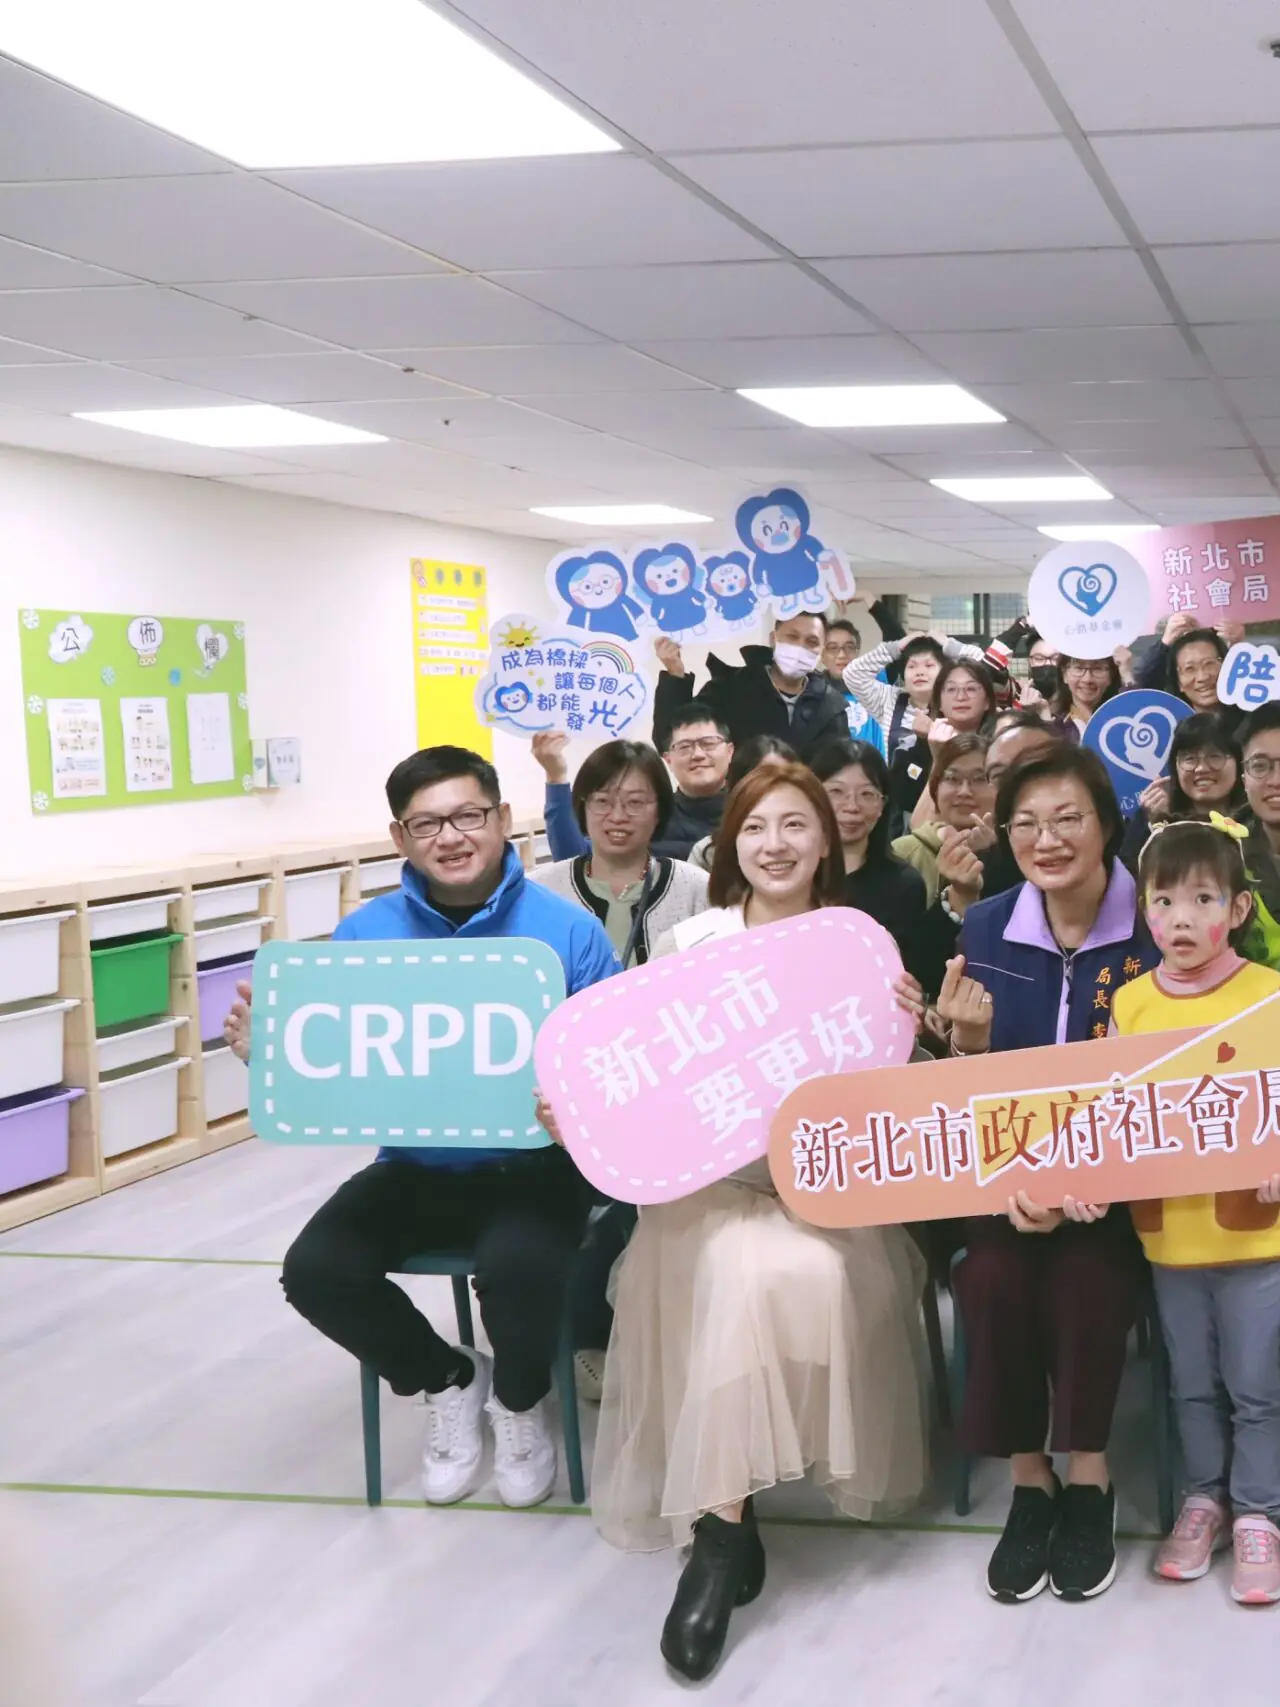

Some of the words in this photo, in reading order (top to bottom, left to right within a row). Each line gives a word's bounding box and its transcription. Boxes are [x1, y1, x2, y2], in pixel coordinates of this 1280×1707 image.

[1163, 539, 1265, 576] 新北市
[1167, 575, 1269, 611] 社會局
[501, 648, 590, 671] 成為橋樑
[537, 693, 581, 711] 都能
[554, 672, 635, 699] 讓每個人
[1093, 967, 1111, 1009] 局長
[284, 1003, 534, 1079] CRPD
[581, 963, 780, 1110] 新北市
[684, 994, 877, 1147] 要更好
